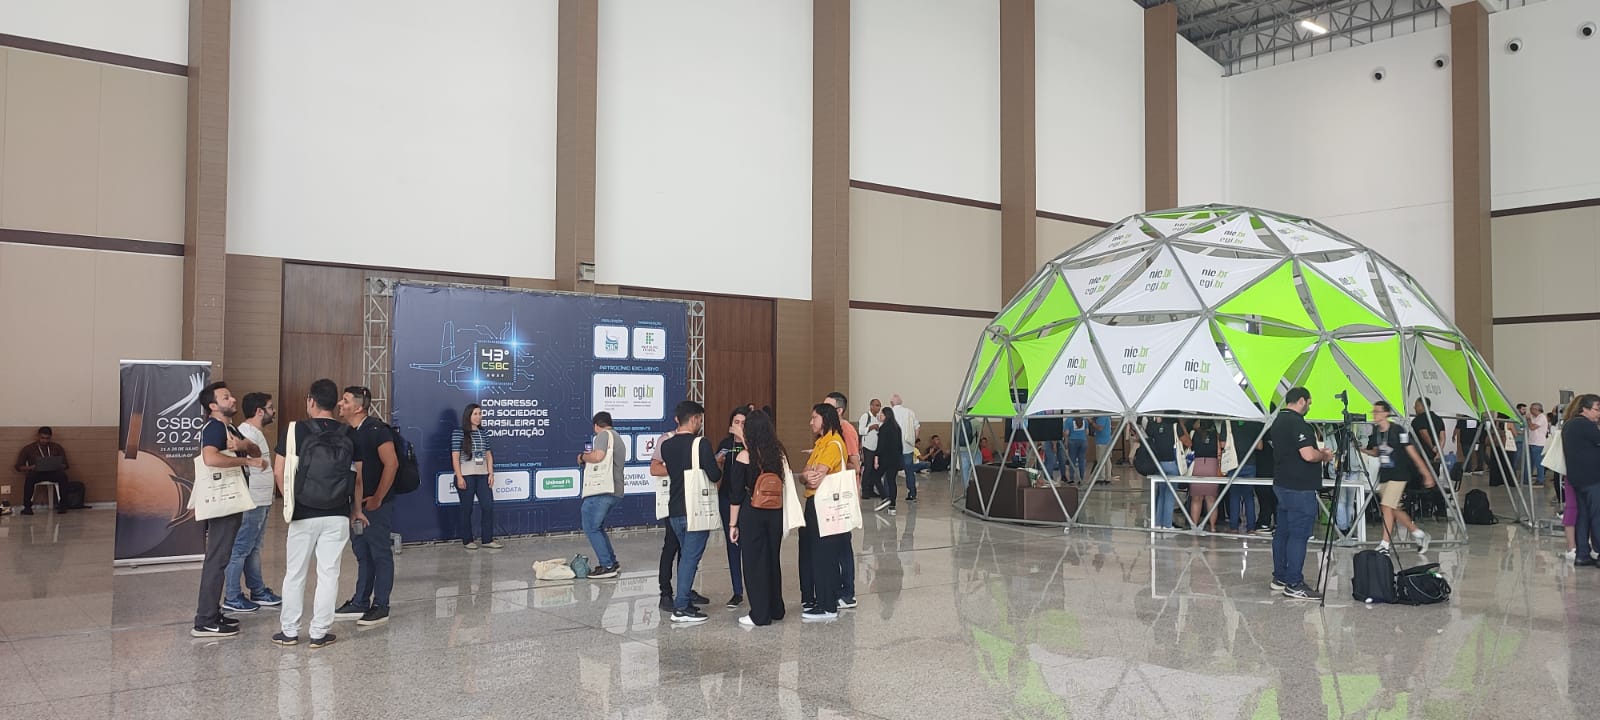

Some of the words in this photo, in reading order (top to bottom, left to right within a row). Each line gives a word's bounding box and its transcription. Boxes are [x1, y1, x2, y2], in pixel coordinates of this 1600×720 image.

[1149, 268, 1172, 278] nic.br
[1202, 267, 1228, 278] nic.br
[1145, 280, 1170, 292] cgi.br
[1200, 278, 1224, 288] cgi.br
[482, 348, 509, 362] 43°
[1124, 345, 1150, 358] nic.br
[482, 362, 509, 370] CSBC
[1066, 356, 1088, 369] nic.br
[1121, 361, 1147, 375] cgi.br
[1184, 358, 1210, 374] nic.br
[1064, 373, 1086, 387] cgi.br
[1184, 376, 1210, 391] cgi.br
[604, 384, 626, 398] nic.br
[633, 384, 654, 400] cgi.br
[156, 417, 204, 430] CSBC
[156, 431, 202, 444] 2024
[488, 427, 544, 438] OMPUTAÇÃO
